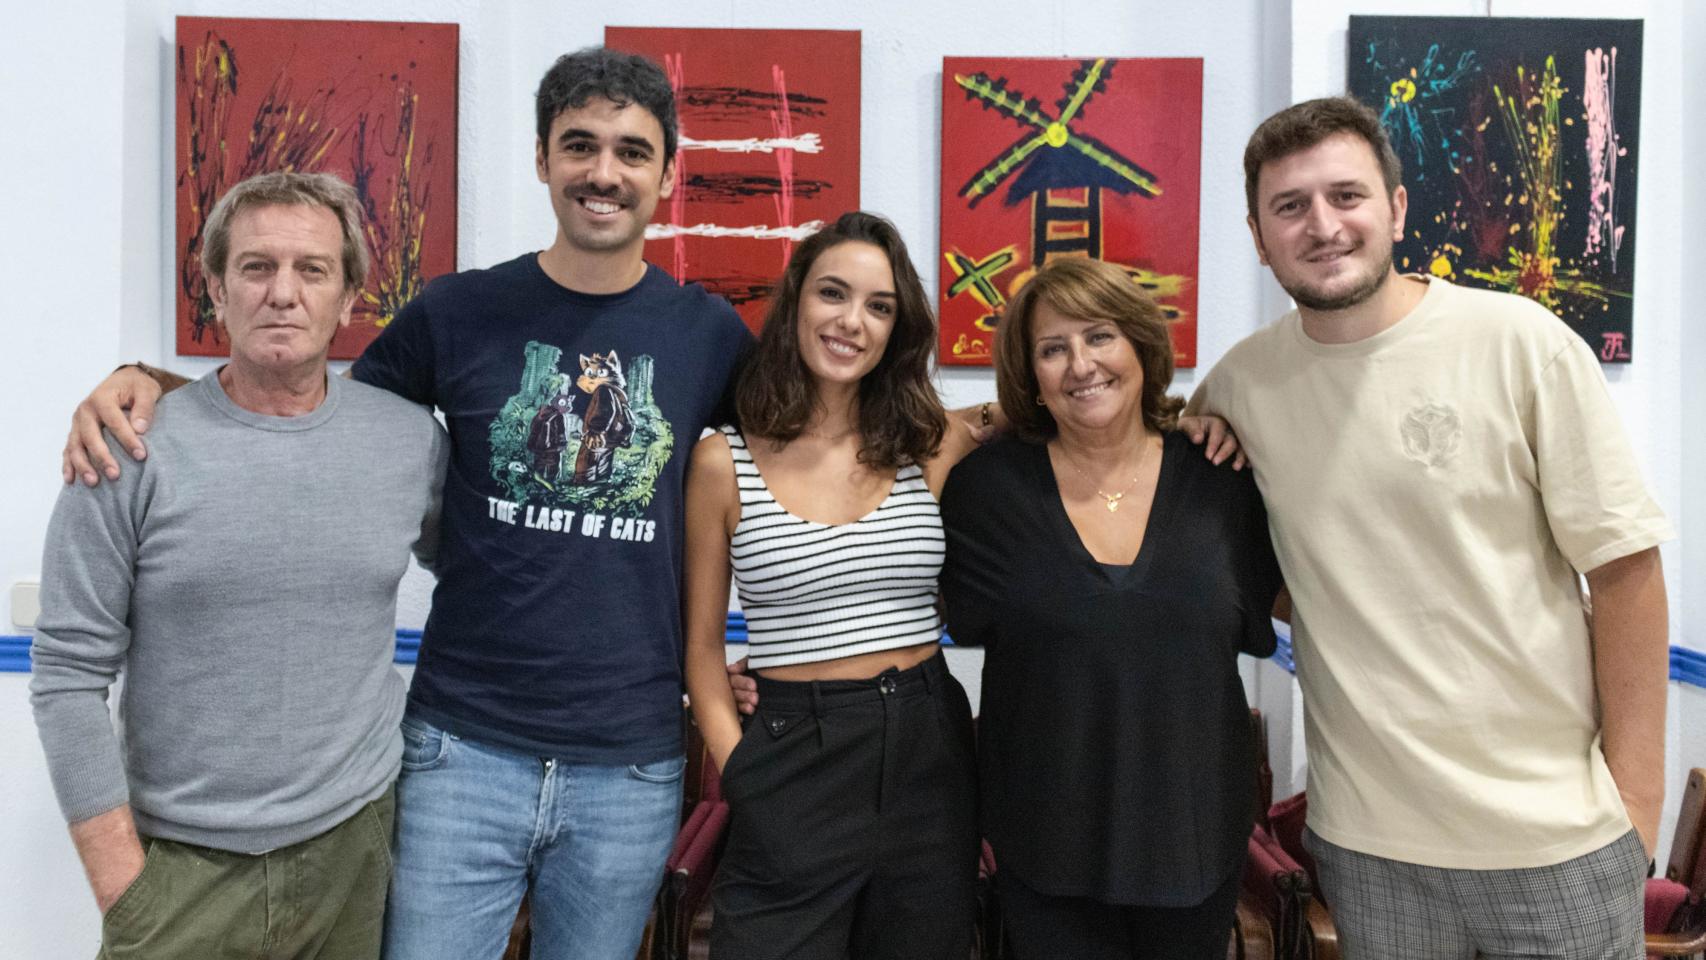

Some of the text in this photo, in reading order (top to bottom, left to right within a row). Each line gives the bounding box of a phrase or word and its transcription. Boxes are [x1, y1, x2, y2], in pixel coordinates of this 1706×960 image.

[487, 496, 656, 543] THE LAST OF CATS
